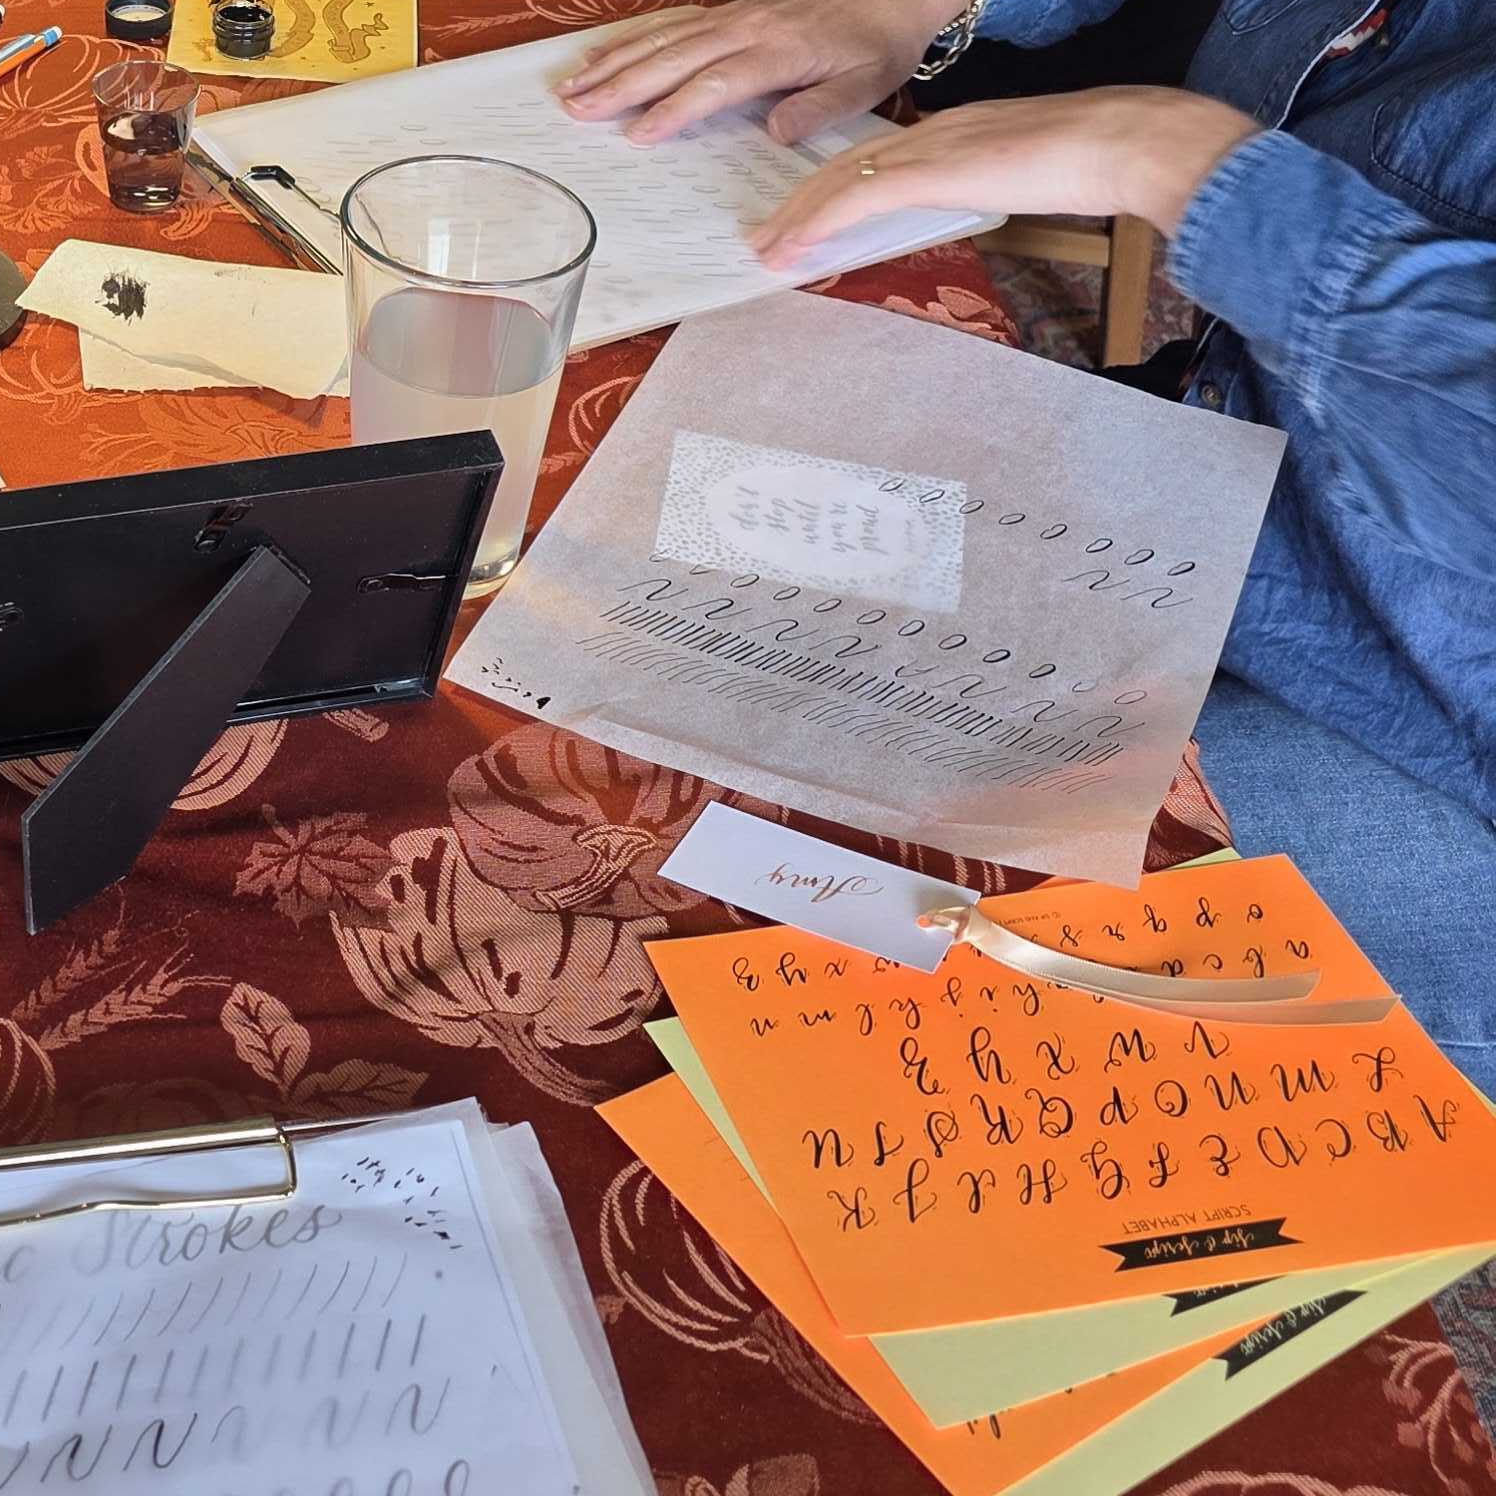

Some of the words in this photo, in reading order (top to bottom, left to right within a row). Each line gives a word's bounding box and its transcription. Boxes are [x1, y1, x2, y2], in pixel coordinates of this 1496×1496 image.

[755, 863, 885, 904] Amy
[1101, 922, 1126, 942] r
[1142, 903, 1168, 934] q
[1195, 896, 1222, 929] p
[1246, 903, 1264, 924] o
[1059, 924, 1083, 948] s
[1284, 939, 1310, 960] a
[732, 957, 760, 992] z
[775, 951, 807, 987] y
[824, 959, 848, 978] x
[1202, 953, 1224, 971] c
[798, 1009, 836, 1027] m
[855, 1003, 877, 1037] l
[888, 997, 921, 1031] k
[1012, 982, 1044, 1017] h
[749, 1017, 778, 1038] n
[1183, 1015, 1230, 1060] V
[899, 1036, 949, 1096] Z
[965, 1026, 1016, 1085] Y
[1035, 1032, 1079, 1081] X
[1103, 1027, 1158, 1074] W
[1351, 1046, 1396, 1094] L
[1153, 1079, 1192, 1118] O
[1203, 1071, 1258, 1112] N
[1270, 1059, 1336, 1103] M
[969, 1093, 1024, 1146] R
[1023, 1087, 1074, 1139] Q
[1099, 1085, 1139, 1126] P
[1412, 1094, 1460, 1143] A
[801, 1128, 855, 1170] U
[873, 1120, 905, 1168] T
[922, 1110, 960, 1159] S
[1256, 1125, 1308, 1169] D
[1315, 1118, 1356, 1162] C
[1366, 1109, 1409, 1153] B
[1079, 1139, 1131, 1201] G
[1148, 1141, 1180, 1189] F
[1199, 1133, 1241, 1178] E
[892, 1157, 938, 1224] J
[1016, 1158, 1068, 1206] H
[826, 1186, 877, 1233] K
[1120, 1212, 1195, 1234] ALPHABET
[1201, 1203, 1251, 1222] SCRIPT
[72, 1203, 344, 1275] Strokes
[1141, 1231, 1198, 1260] Script
[1221, 1226, 1255, 1249] Sip
[1238, 1319, 1283, 1356] Script
